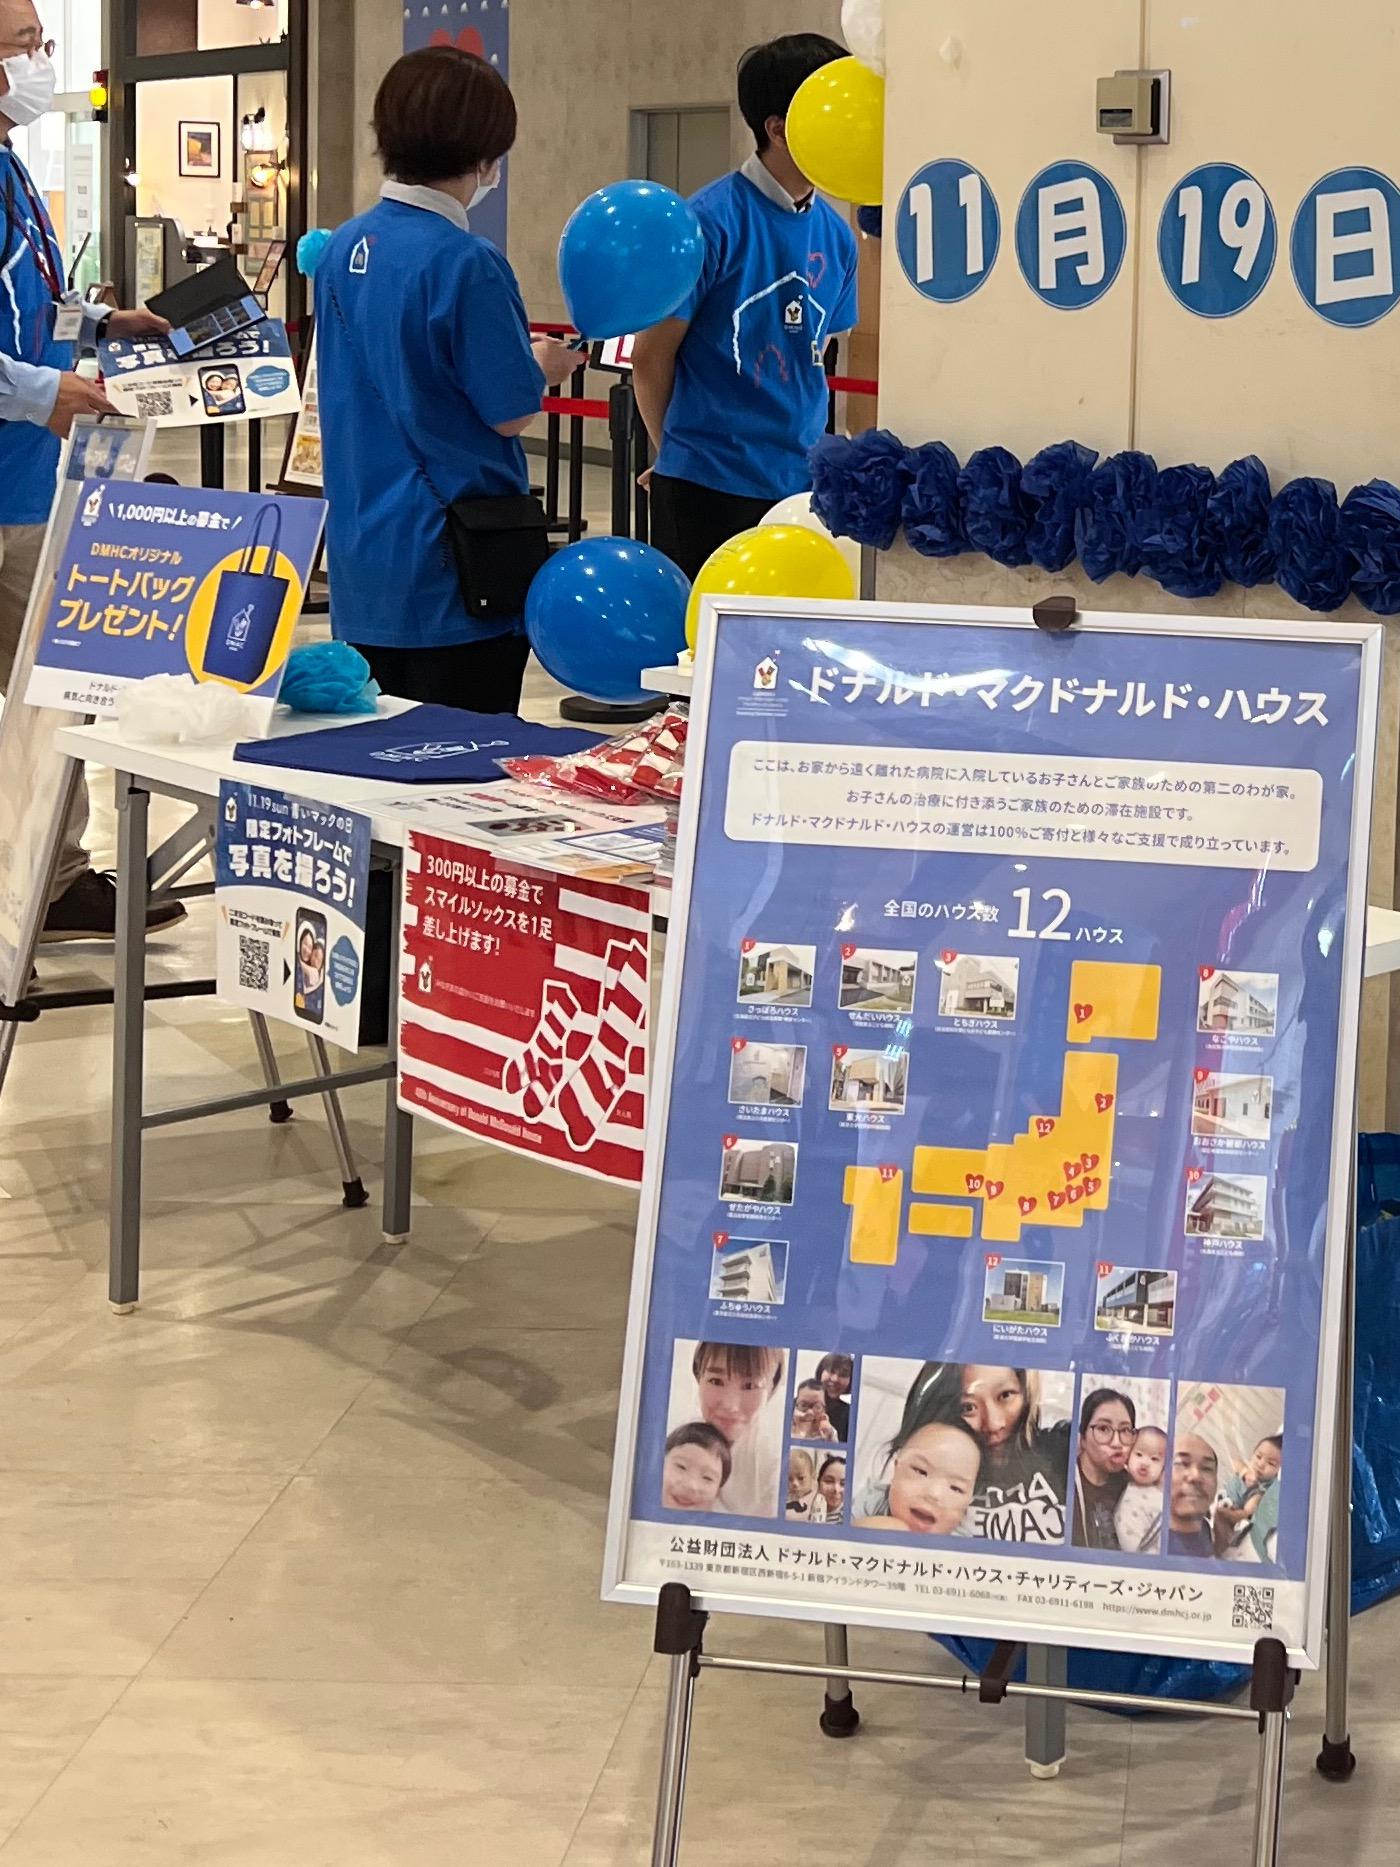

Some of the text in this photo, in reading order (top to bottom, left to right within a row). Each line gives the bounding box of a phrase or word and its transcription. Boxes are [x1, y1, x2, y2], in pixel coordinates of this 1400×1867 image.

[909, 173, 1395, 305] 11月19日
[90, 542, 182, 565] DMHCオリジナル
[67, 563, 196, 604] トートバッグ
[56, 599, 185, 641] プレゼント!
[810, 664, 1329, 727] ドナルド・マクドナルド・ハウス
[245, 818, 353, 867] 限定フォトフレームで
[228, 844, 356, 909] 写真を撮ろう!
[426, 854, 544, 906] 300円以上の募金で
[424, 886, 554, 942] スマイルソックスを1足
[1007, 887, 1072, 941] 12
[1075, 926, 1124, 945] ハウス
[422, 915, 501, 957] 差し上げます!
[738, 1105, 790, 1117] さいたまハウス
[1039, 1122, 1051, 1133] 12
[968, 1178, 981, 1190] 10
[728, 1203, 781, 1215] せたがやハウス
[993, 1324, 1048, 1337] にいがたハウス
[670, 1536, 1204, 1602] 公益財団法人 ドナルド・マクドナルド・ハウス・チャリティーズ・ジャパン
